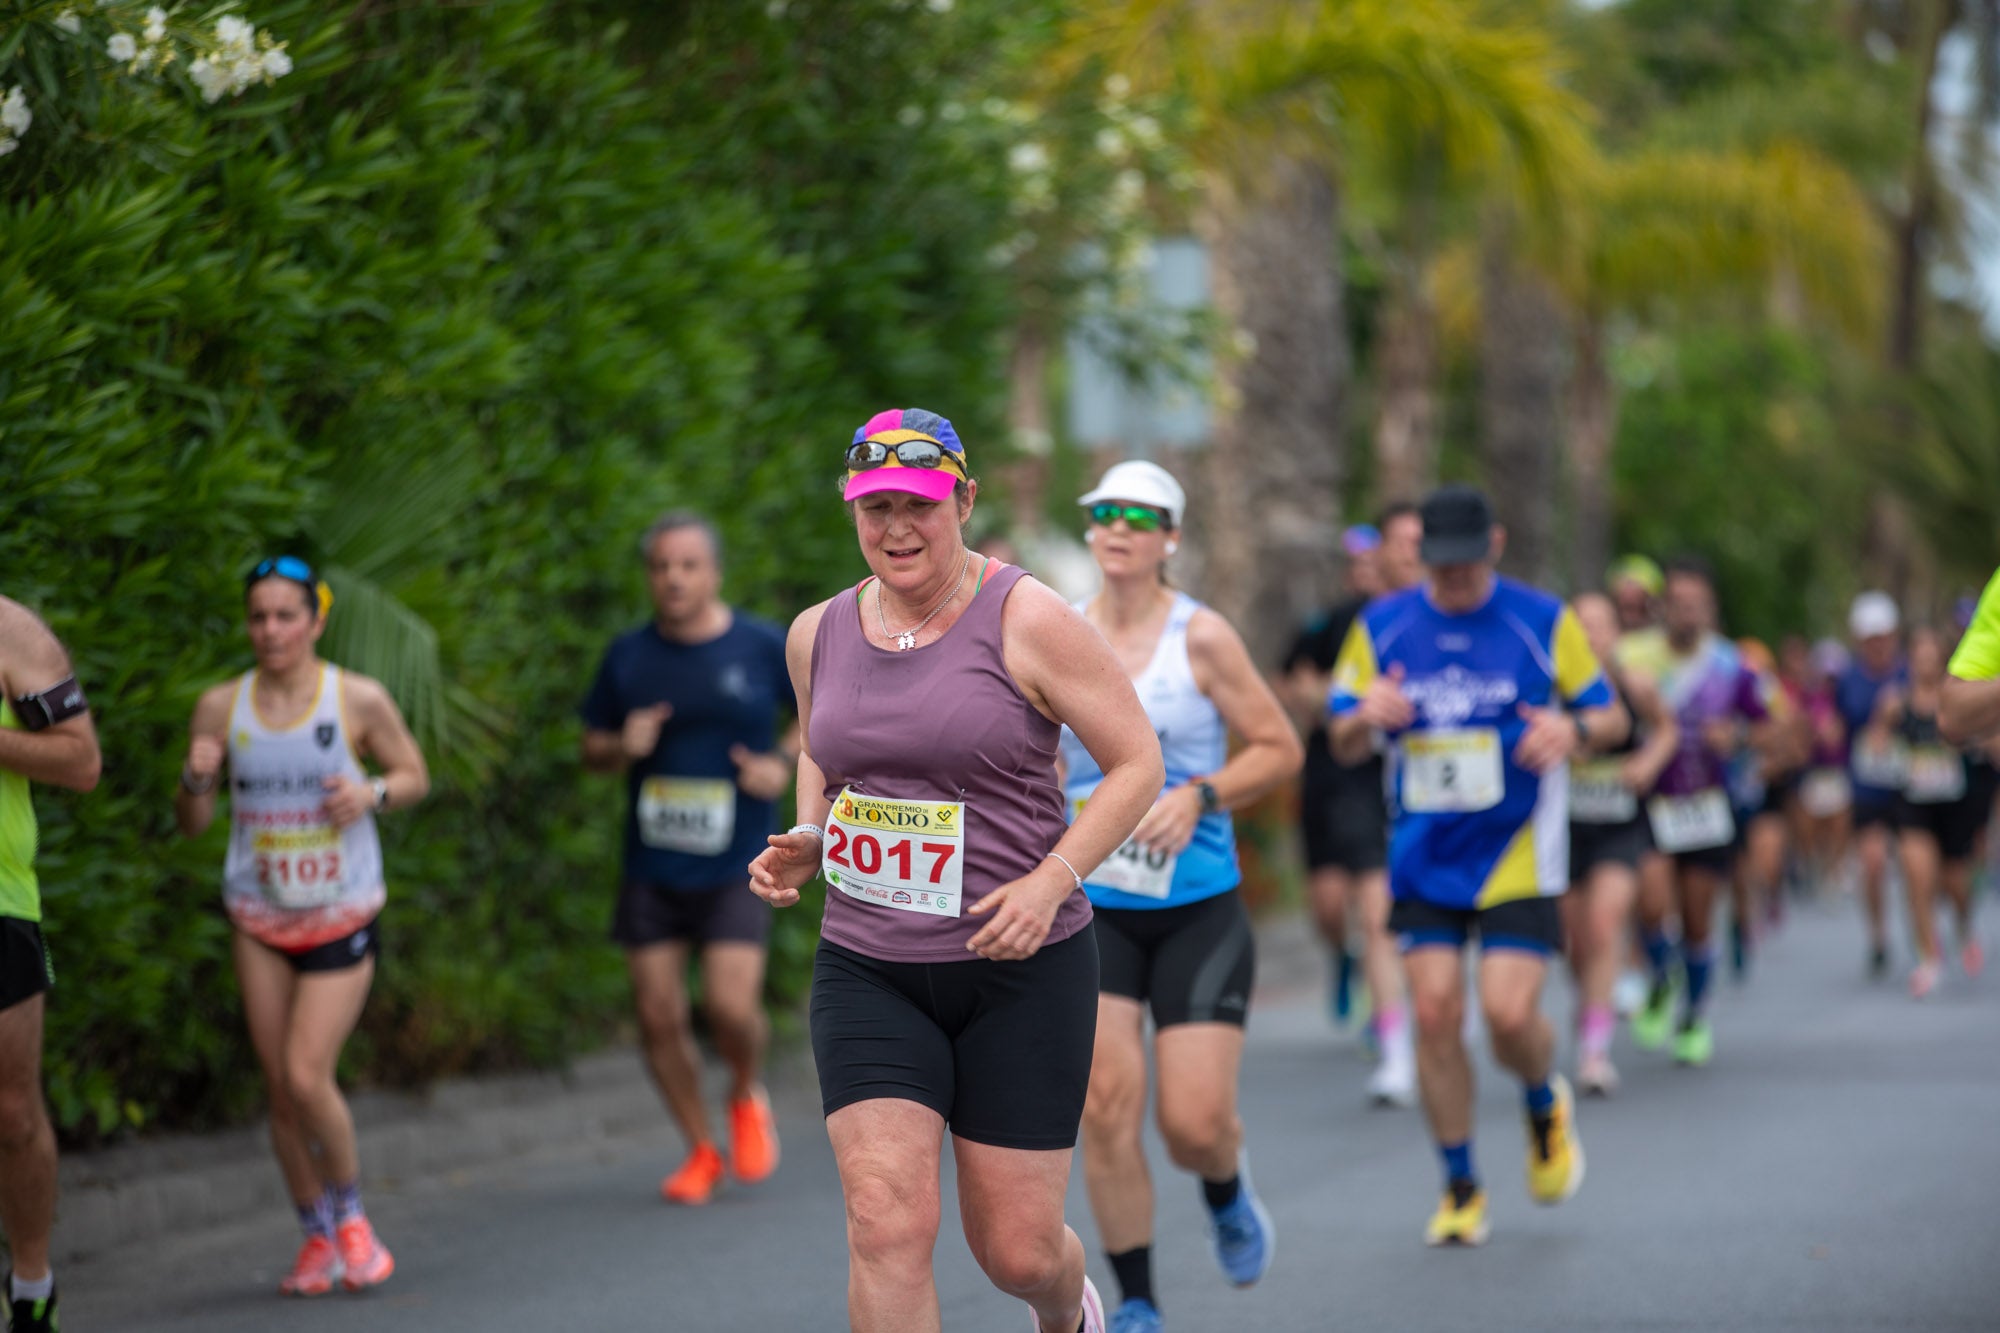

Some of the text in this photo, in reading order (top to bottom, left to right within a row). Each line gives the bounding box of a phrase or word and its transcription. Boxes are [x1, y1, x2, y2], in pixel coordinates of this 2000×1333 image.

[854, 807, 929, 828] FONDO
[857, 801, 884, 810] GRAN
[886, 804, 922, 814] PREMIO
[827, 823, 956, 884] 2017
[256, 851, 341, 887] 2102
